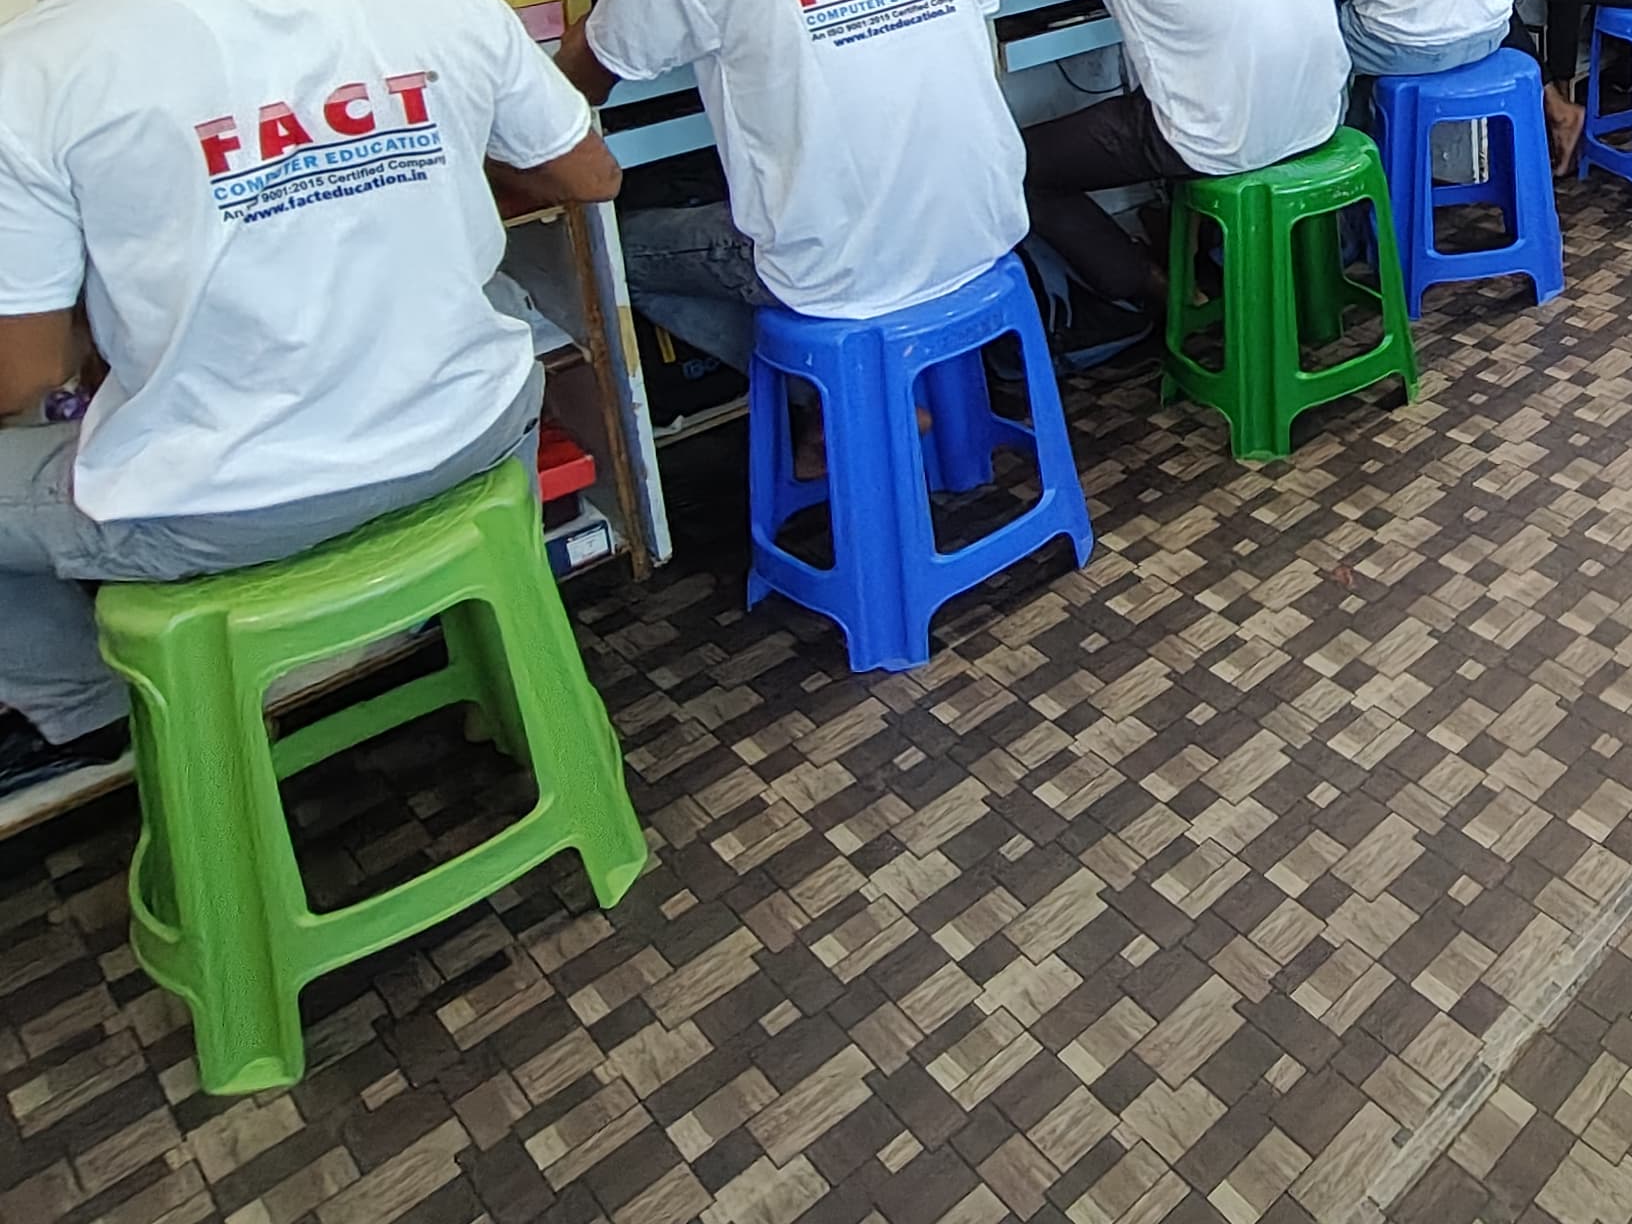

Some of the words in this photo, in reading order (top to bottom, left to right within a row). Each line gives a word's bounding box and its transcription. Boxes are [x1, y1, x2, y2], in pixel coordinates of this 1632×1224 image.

[834, 5, 956, 47] www.facteducation.in
[194, 71, 431, 176] FACT
[326, 130, 441, 165] EDUCATION
[223, 209, 244, 222] An
[261, 177, 324, 203] 9001:2015
[328, 163, 385, 186] Certified
[243, 169, 428, 224] www.facteducation.in
